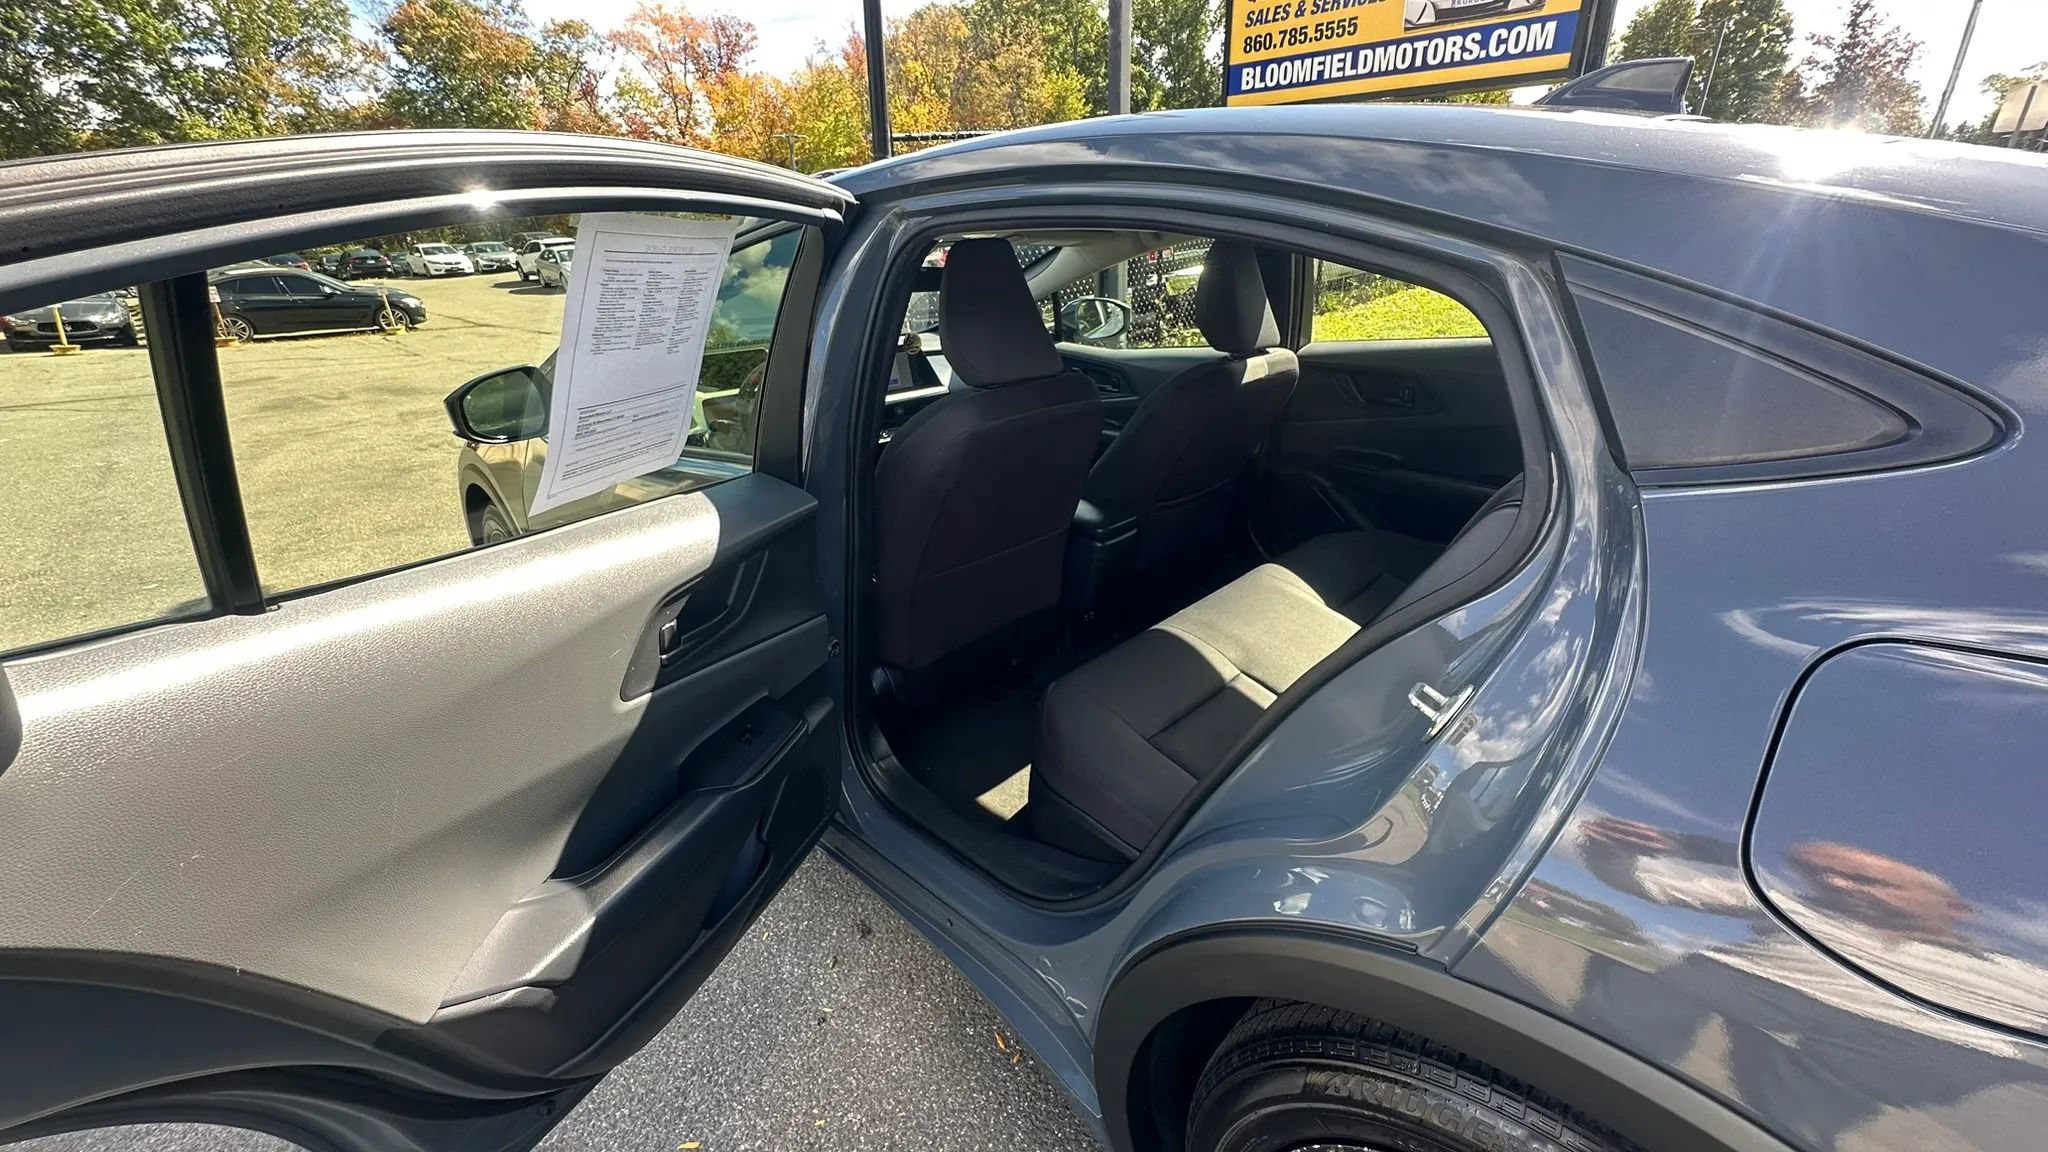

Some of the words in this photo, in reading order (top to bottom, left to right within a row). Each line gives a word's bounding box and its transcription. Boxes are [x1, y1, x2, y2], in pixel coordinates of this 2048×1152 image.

[1245, 3, 1291, 28] SALES
[1294, 0, 1307, 18] &
[1243, 16, 1359, 54] 860.785.5555
[1240, 20, 1558, 91] BLOOMFIELDMOTORS.COM
